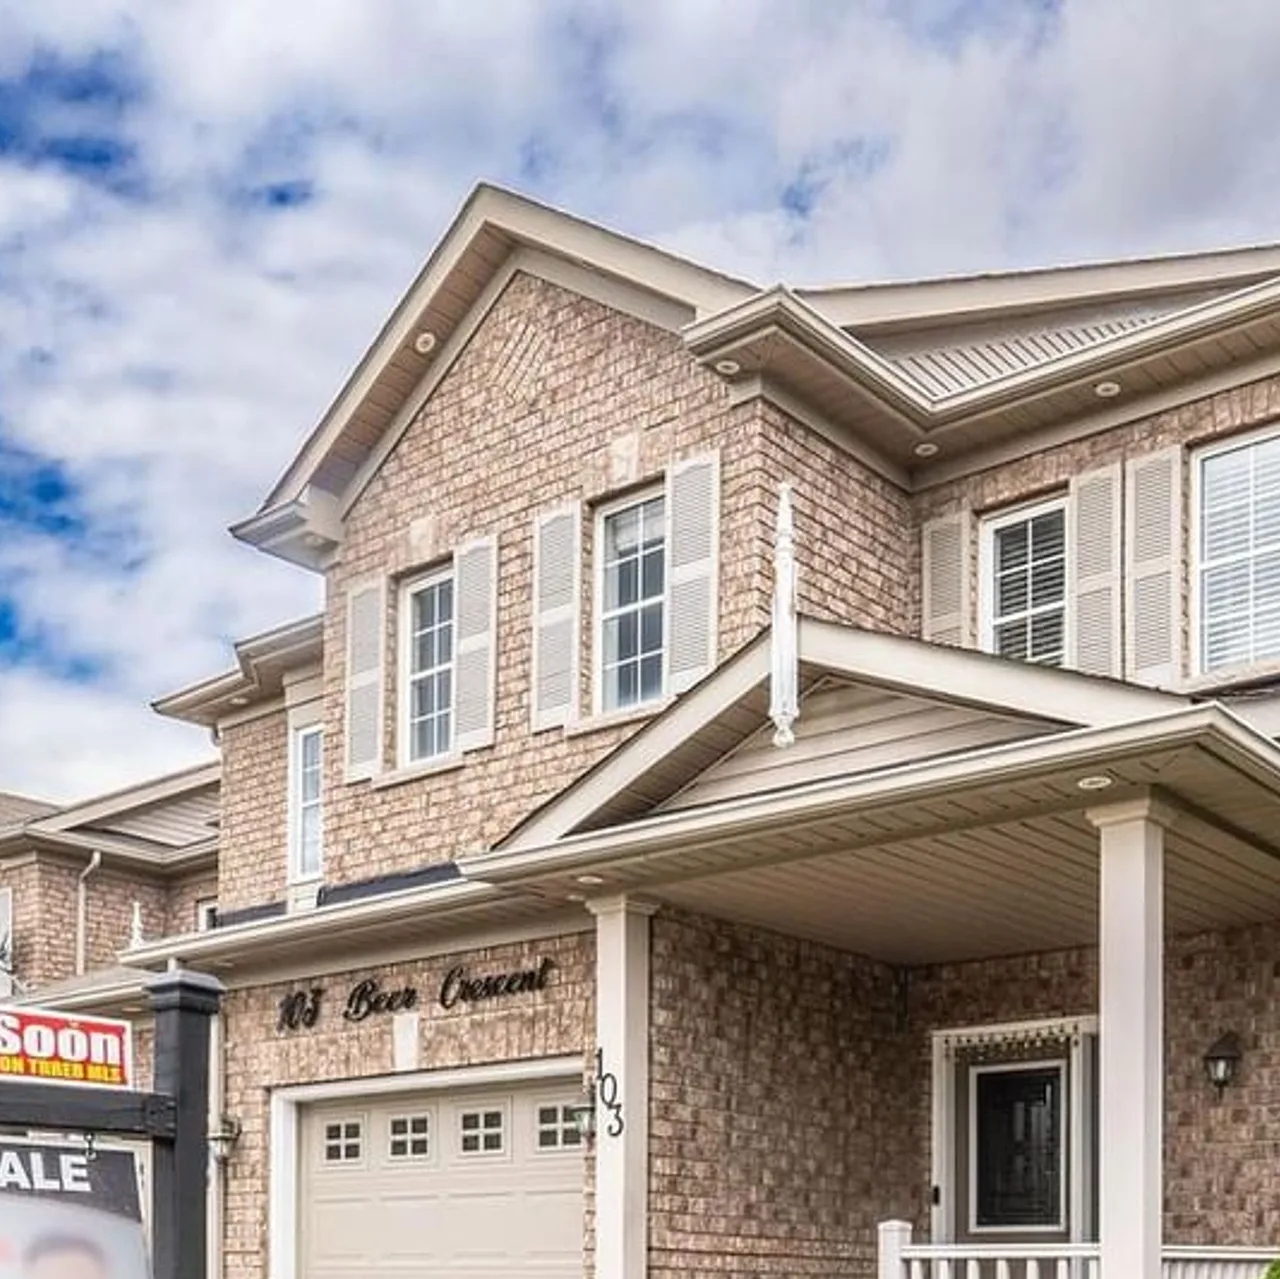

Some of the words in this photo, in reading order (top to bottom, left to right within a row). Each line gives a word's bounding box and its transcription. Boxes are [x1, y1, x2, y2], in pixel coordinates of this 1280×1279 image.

[342, 978, 418, 1022] Beer
[439, 957, 557, 1010] Crescent
[596, 1046, 625, 1137] 103
